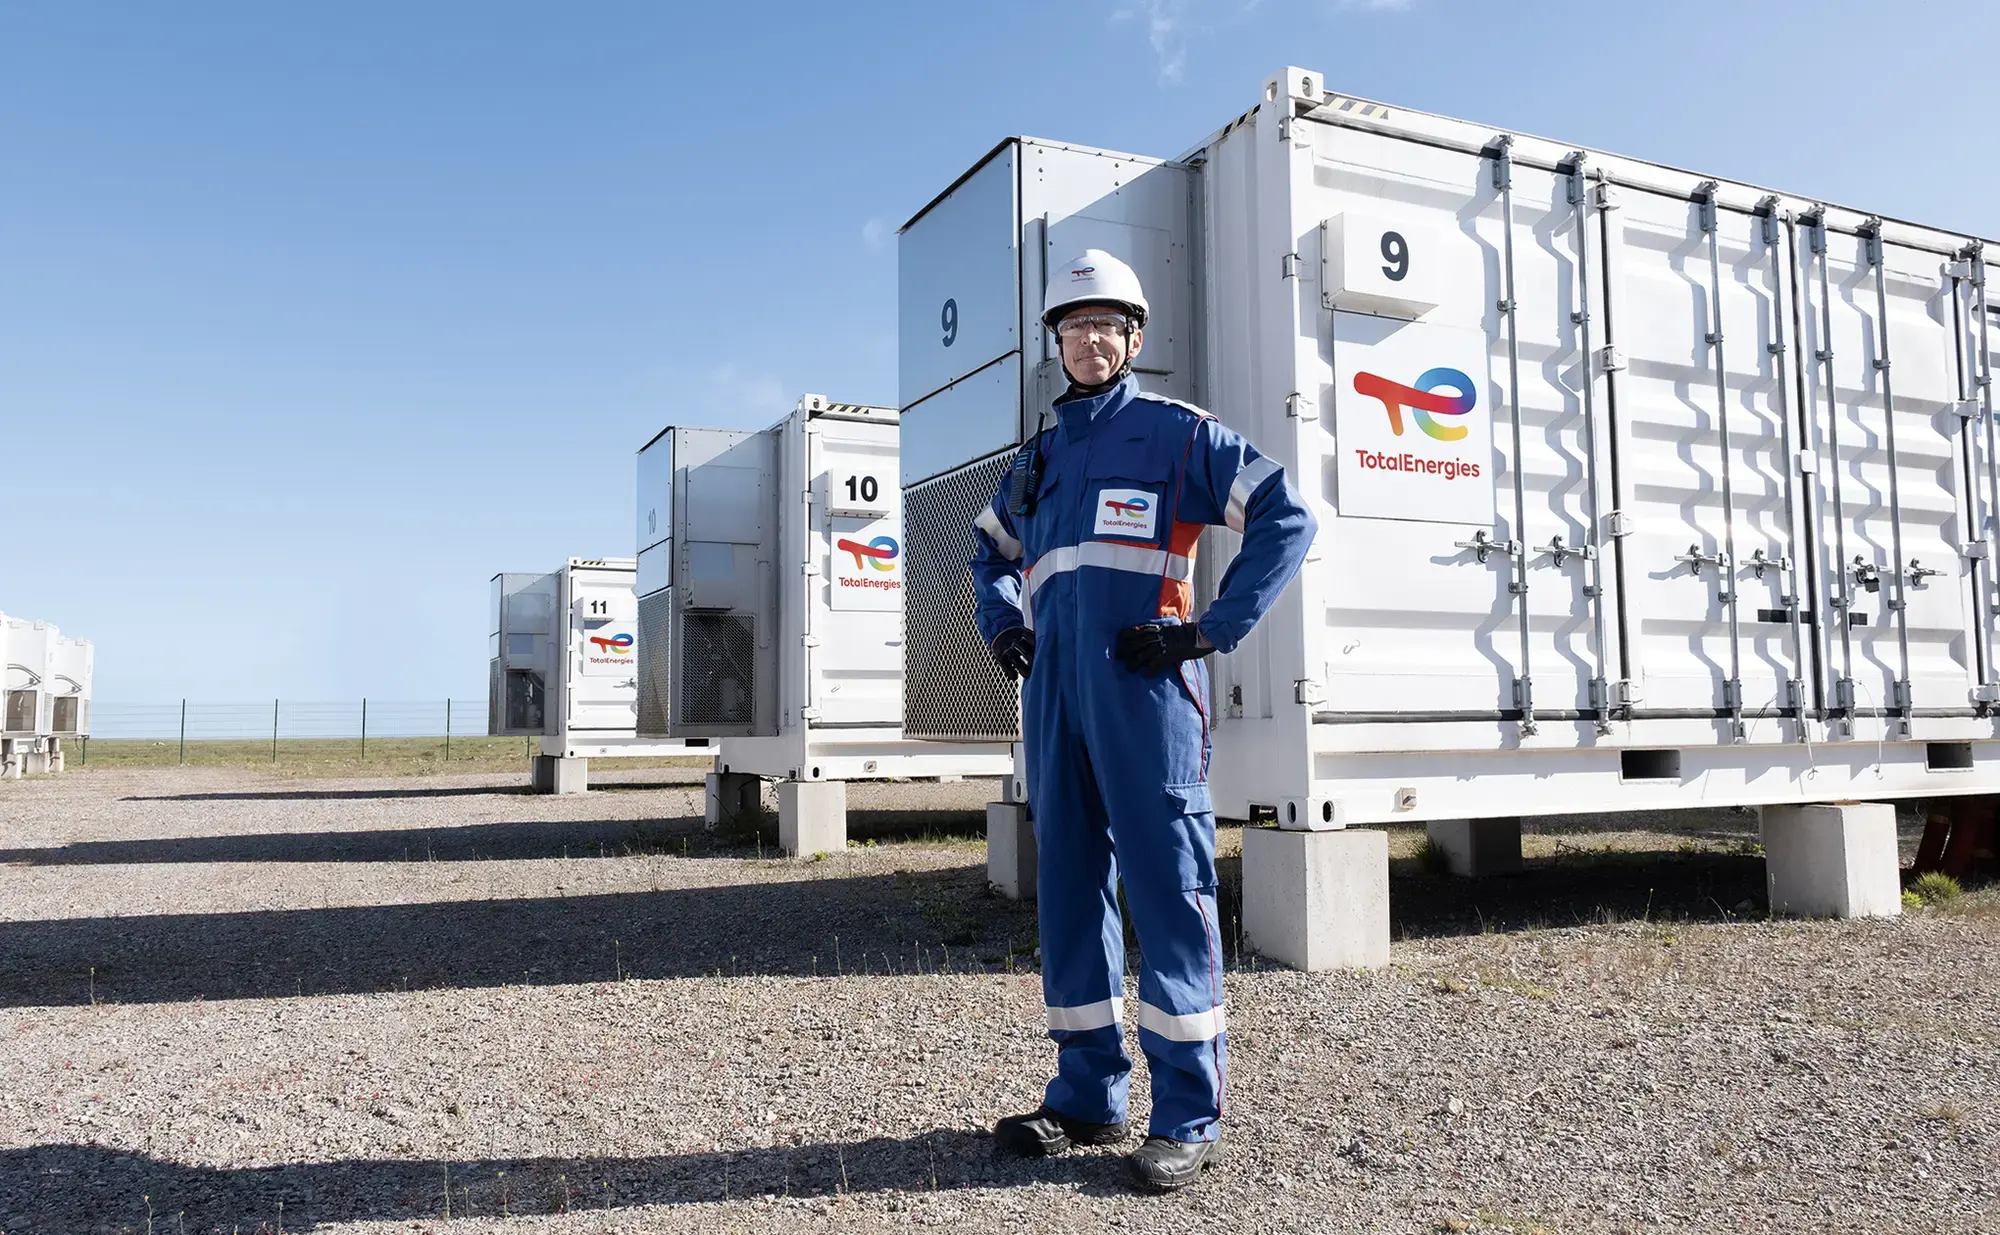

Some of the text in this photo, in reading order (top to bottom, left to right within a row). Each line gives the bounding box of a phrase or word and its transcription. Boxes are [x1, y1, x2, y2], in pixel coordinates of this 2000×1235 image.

[1381, 231, 1410, 281] 9
[941, 298, 958, 347] 9
[1355, 449, 1480, 480] TotalEnergies
[845, 475, 878, 502] 10
[648, 508, 656, 535] 10
[1102, 519, 1147, 529] TotalEnergies
[838, 576, 901, 591] TotalEnergies
[590, 600, 607, 614] 11
[589, 657, 634, 665] TotalEnergies
